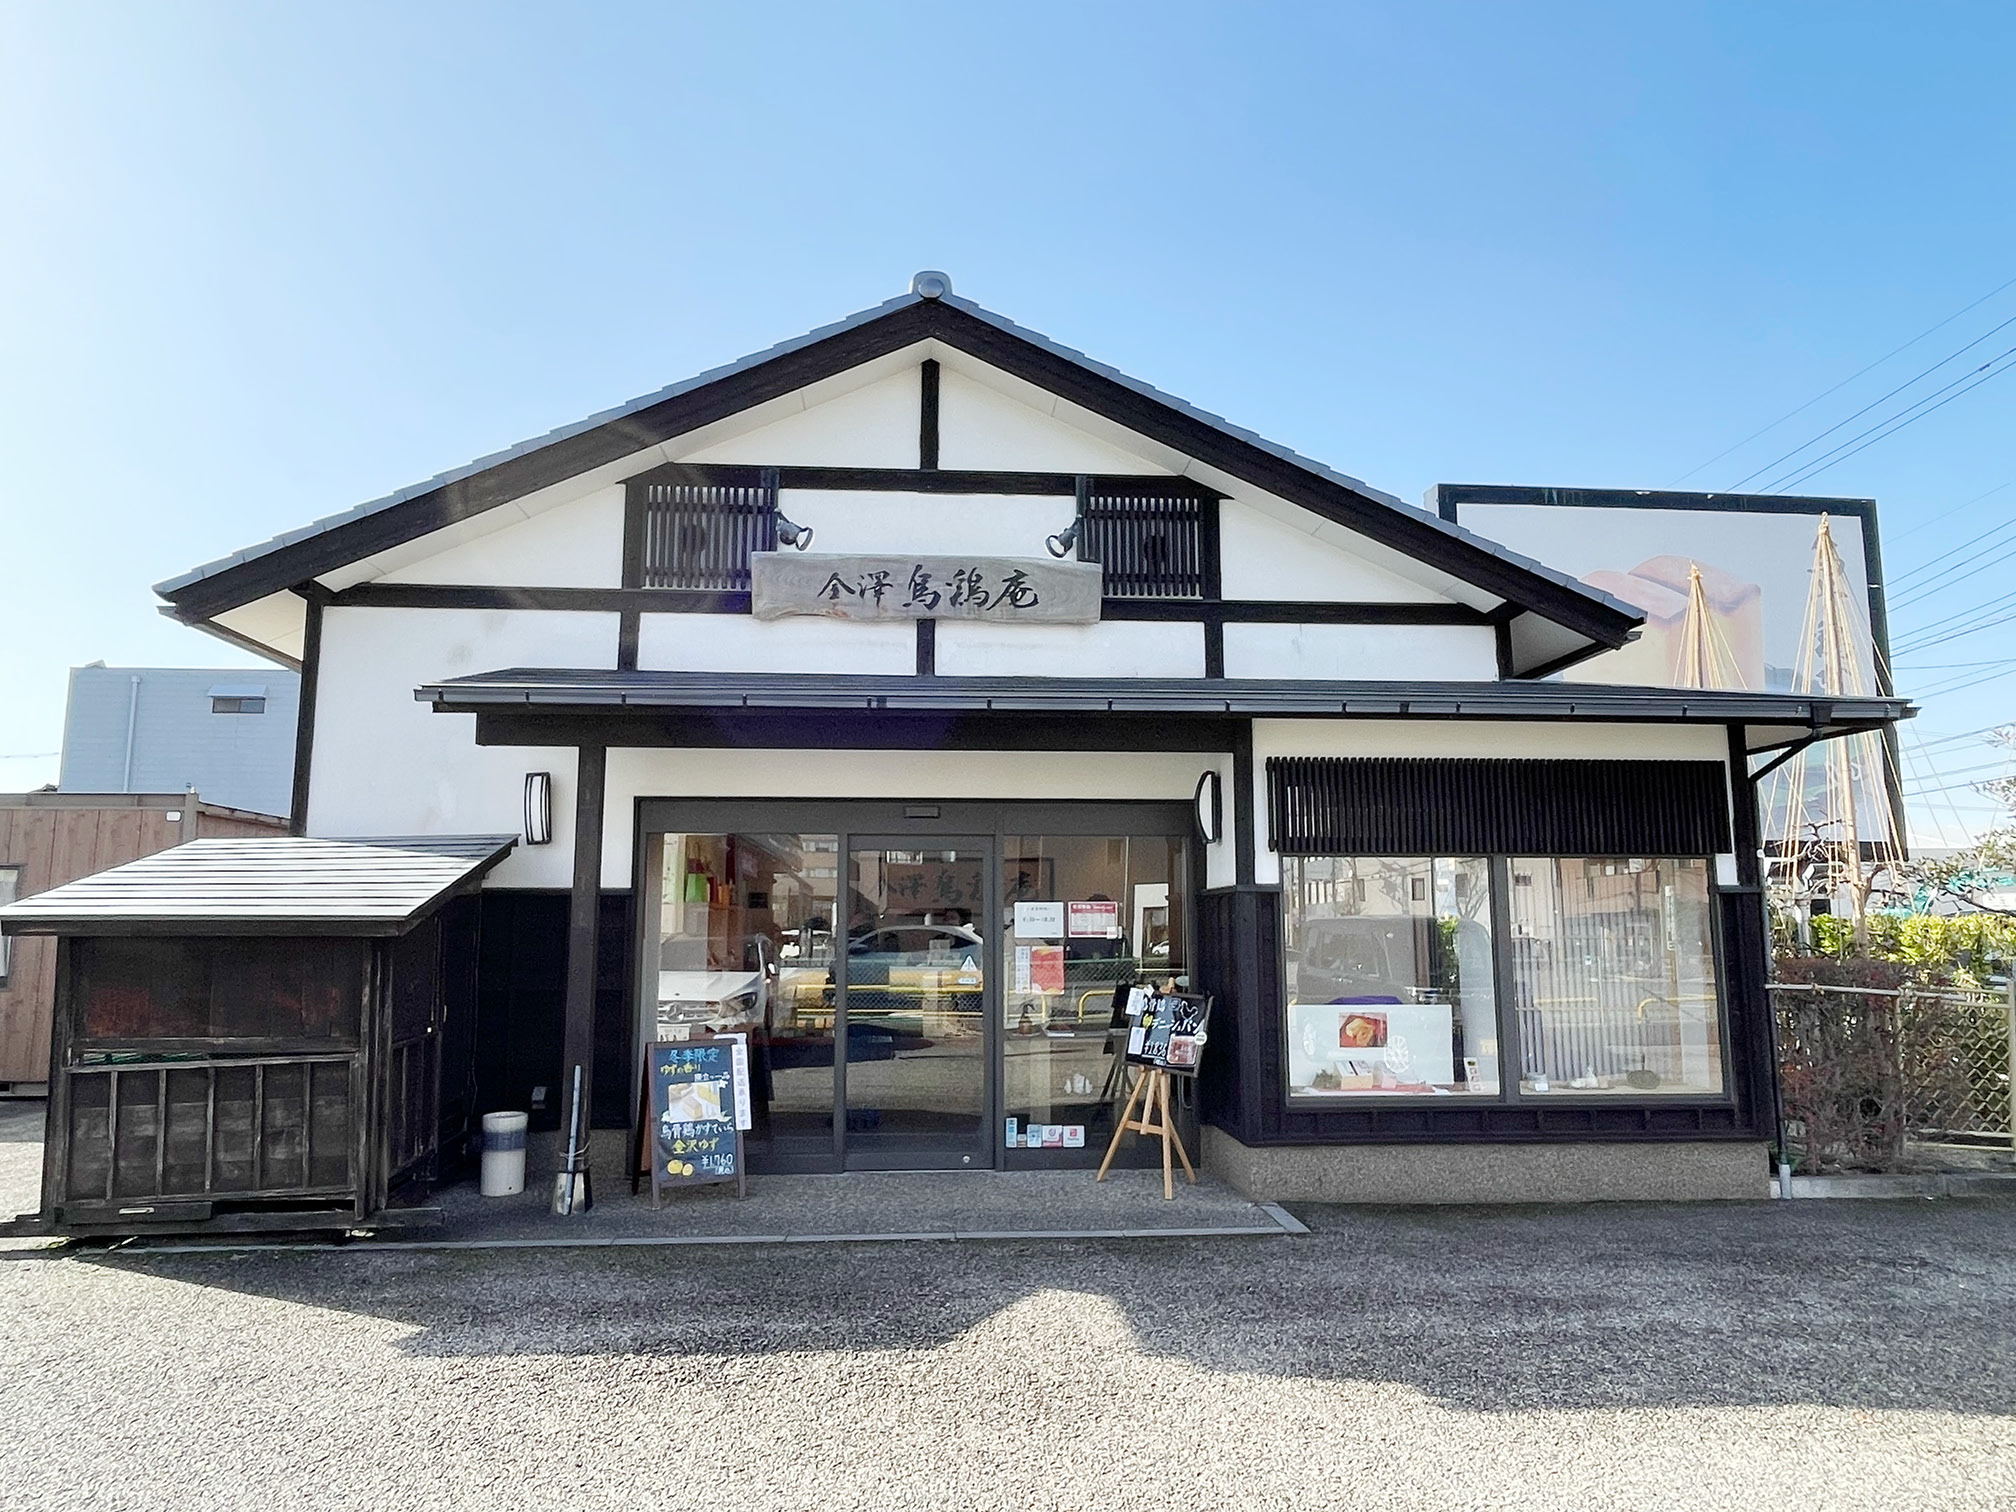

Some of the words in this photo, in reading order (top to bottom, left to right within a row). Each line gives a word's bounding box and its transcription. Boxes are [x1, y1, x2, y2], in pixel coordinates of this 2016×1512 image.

[669, 1047, 719, 1063] 冬季限定
[660, 1062, 702, 1076] ゆずの香り
[661, 1122, 735, 1139] 烏骨鶏かすていら
[672, 1137, 720, 1154] 金沢ゆず
